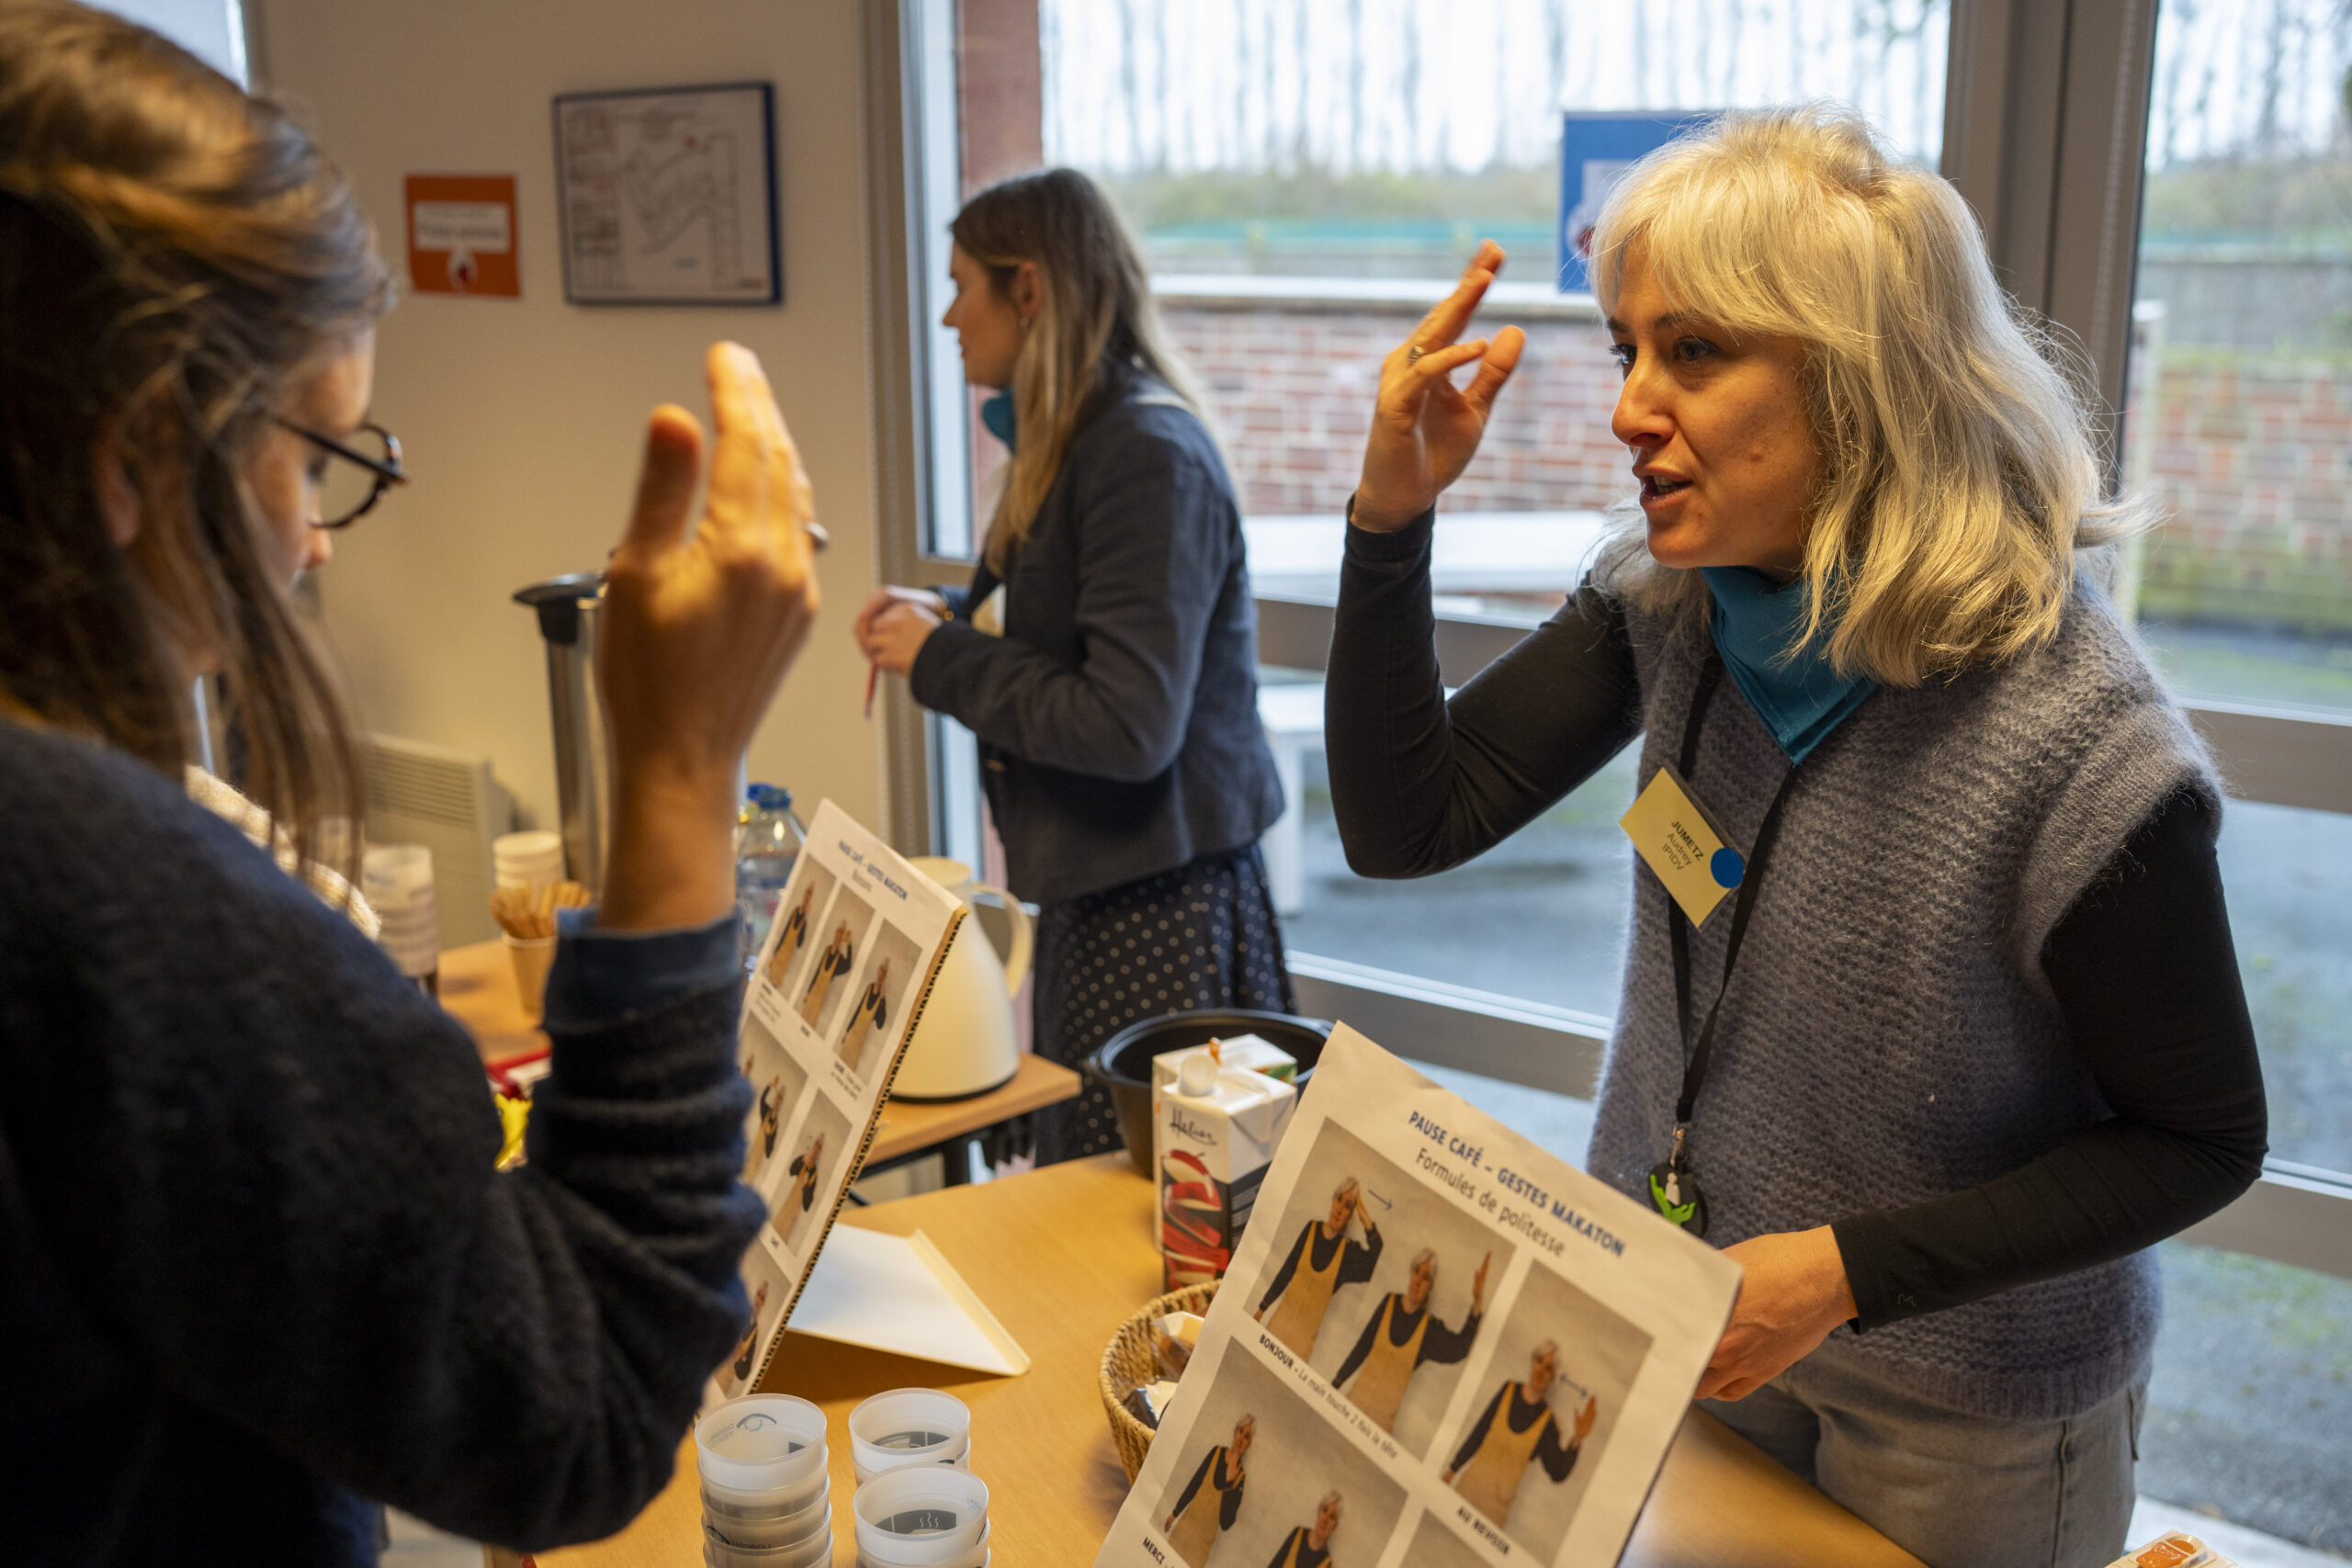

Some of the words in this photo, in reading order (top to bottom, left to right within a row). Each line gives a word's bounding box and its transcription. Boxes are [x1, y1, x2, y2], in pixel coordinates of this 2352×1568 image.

[1667, 833, 1692, 866] Audrey
[1671, 821, 1704, 862] JUMETZ
[1408, 1111, 1448, 1146] PAUSE
[1448, 1137, 1485, 1168] CAFÉ
[1497, 1168, 1549, 1209] GESTES
[1550, 1199, 1626, 1258] MAKATON
[1415, 1146, 1477, 1200] Formules
[1478, 1190, 1498, 1213] de
[1497, 1204, 1566, 1258] politesse
[1259, 1334, 1295, 1370] BONJOUR
[1298, 1369, 1307, 1382] La
[1307, 1379, 1326, 1397] main
[1326, 1393, 1351, 1419] touche
[1350, 1413, 1359, 1425] 2
[1142, 1536, 1165, 1565] MERCI
